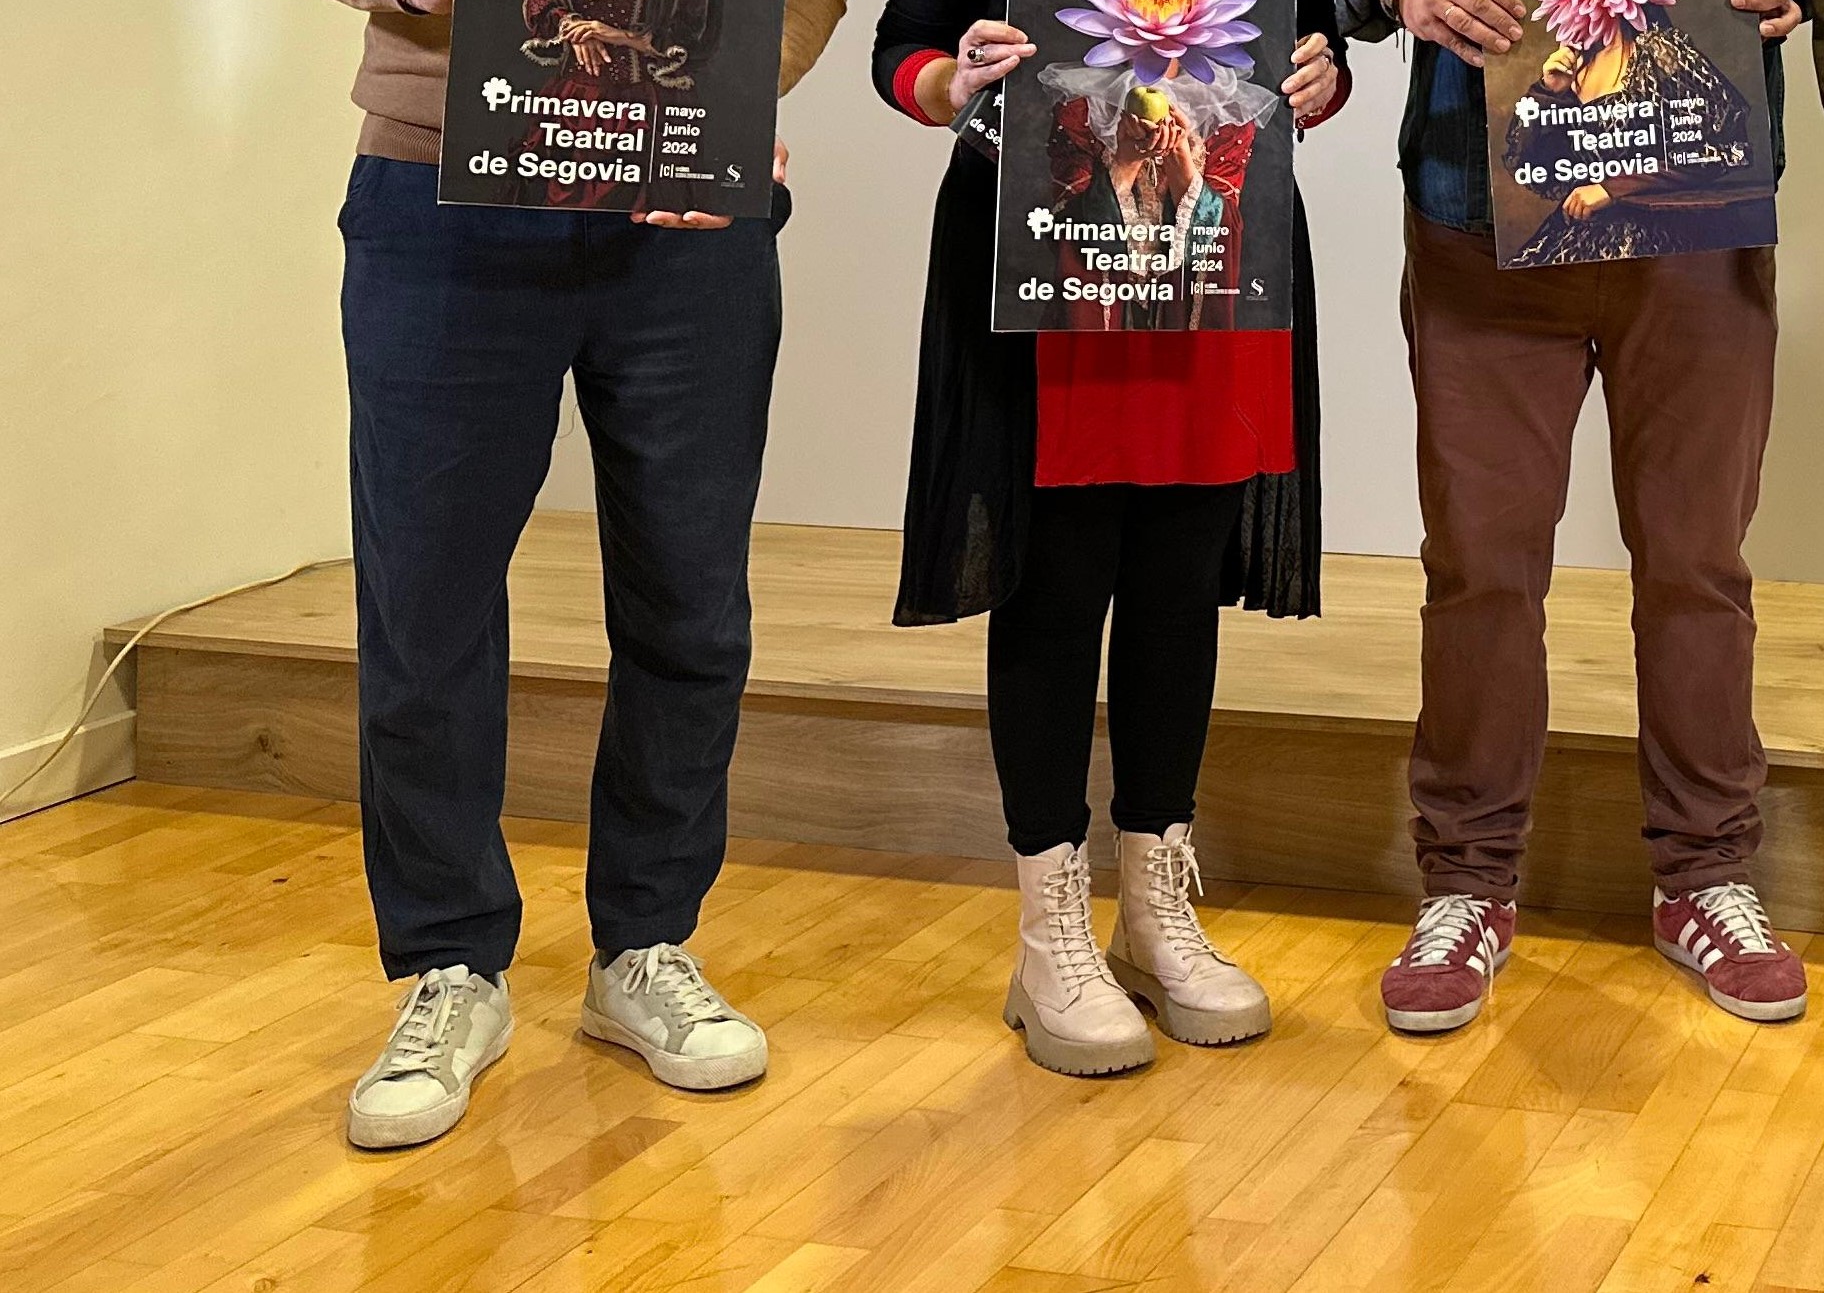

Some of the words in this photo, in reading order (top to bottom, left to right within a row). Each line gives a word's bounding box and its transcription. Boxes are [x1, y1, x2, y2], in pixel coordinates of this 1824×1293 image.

[481, 76, 646, 121] Primavera
[1670, 97, 1705, 109] mayo
[665, 106, 706, 119] mayo
[1515, 96, 1654, 127] Primavera
[662, 122, 700, 136] junio
[1670, 114, 1702, 129] junio
[540, 122, 643, 151] Teatral
[1567, 124, 1656, 151] Teatral
[1672, 130, 1702, 143] 2024
[661, 141, 697, 154] 2024
[468, 150, 508, 175] de
[517, 152, 641, 184] Segovia
[1514, 162, 1548, 185] de
[1554, 153, 1658, 183] Segovia
[1026, 207, 1175, 241] Primavera
[1192, 226, 1229, 238] mayo
[1191, 241, 1225, 255] junio
[1081, 247, 1174, 271] Teatral
[1191, 260, 1223, 271] 2024
[1018, 277, 1054, 300] de
[1062, 277, 1174, 306] Segovia
